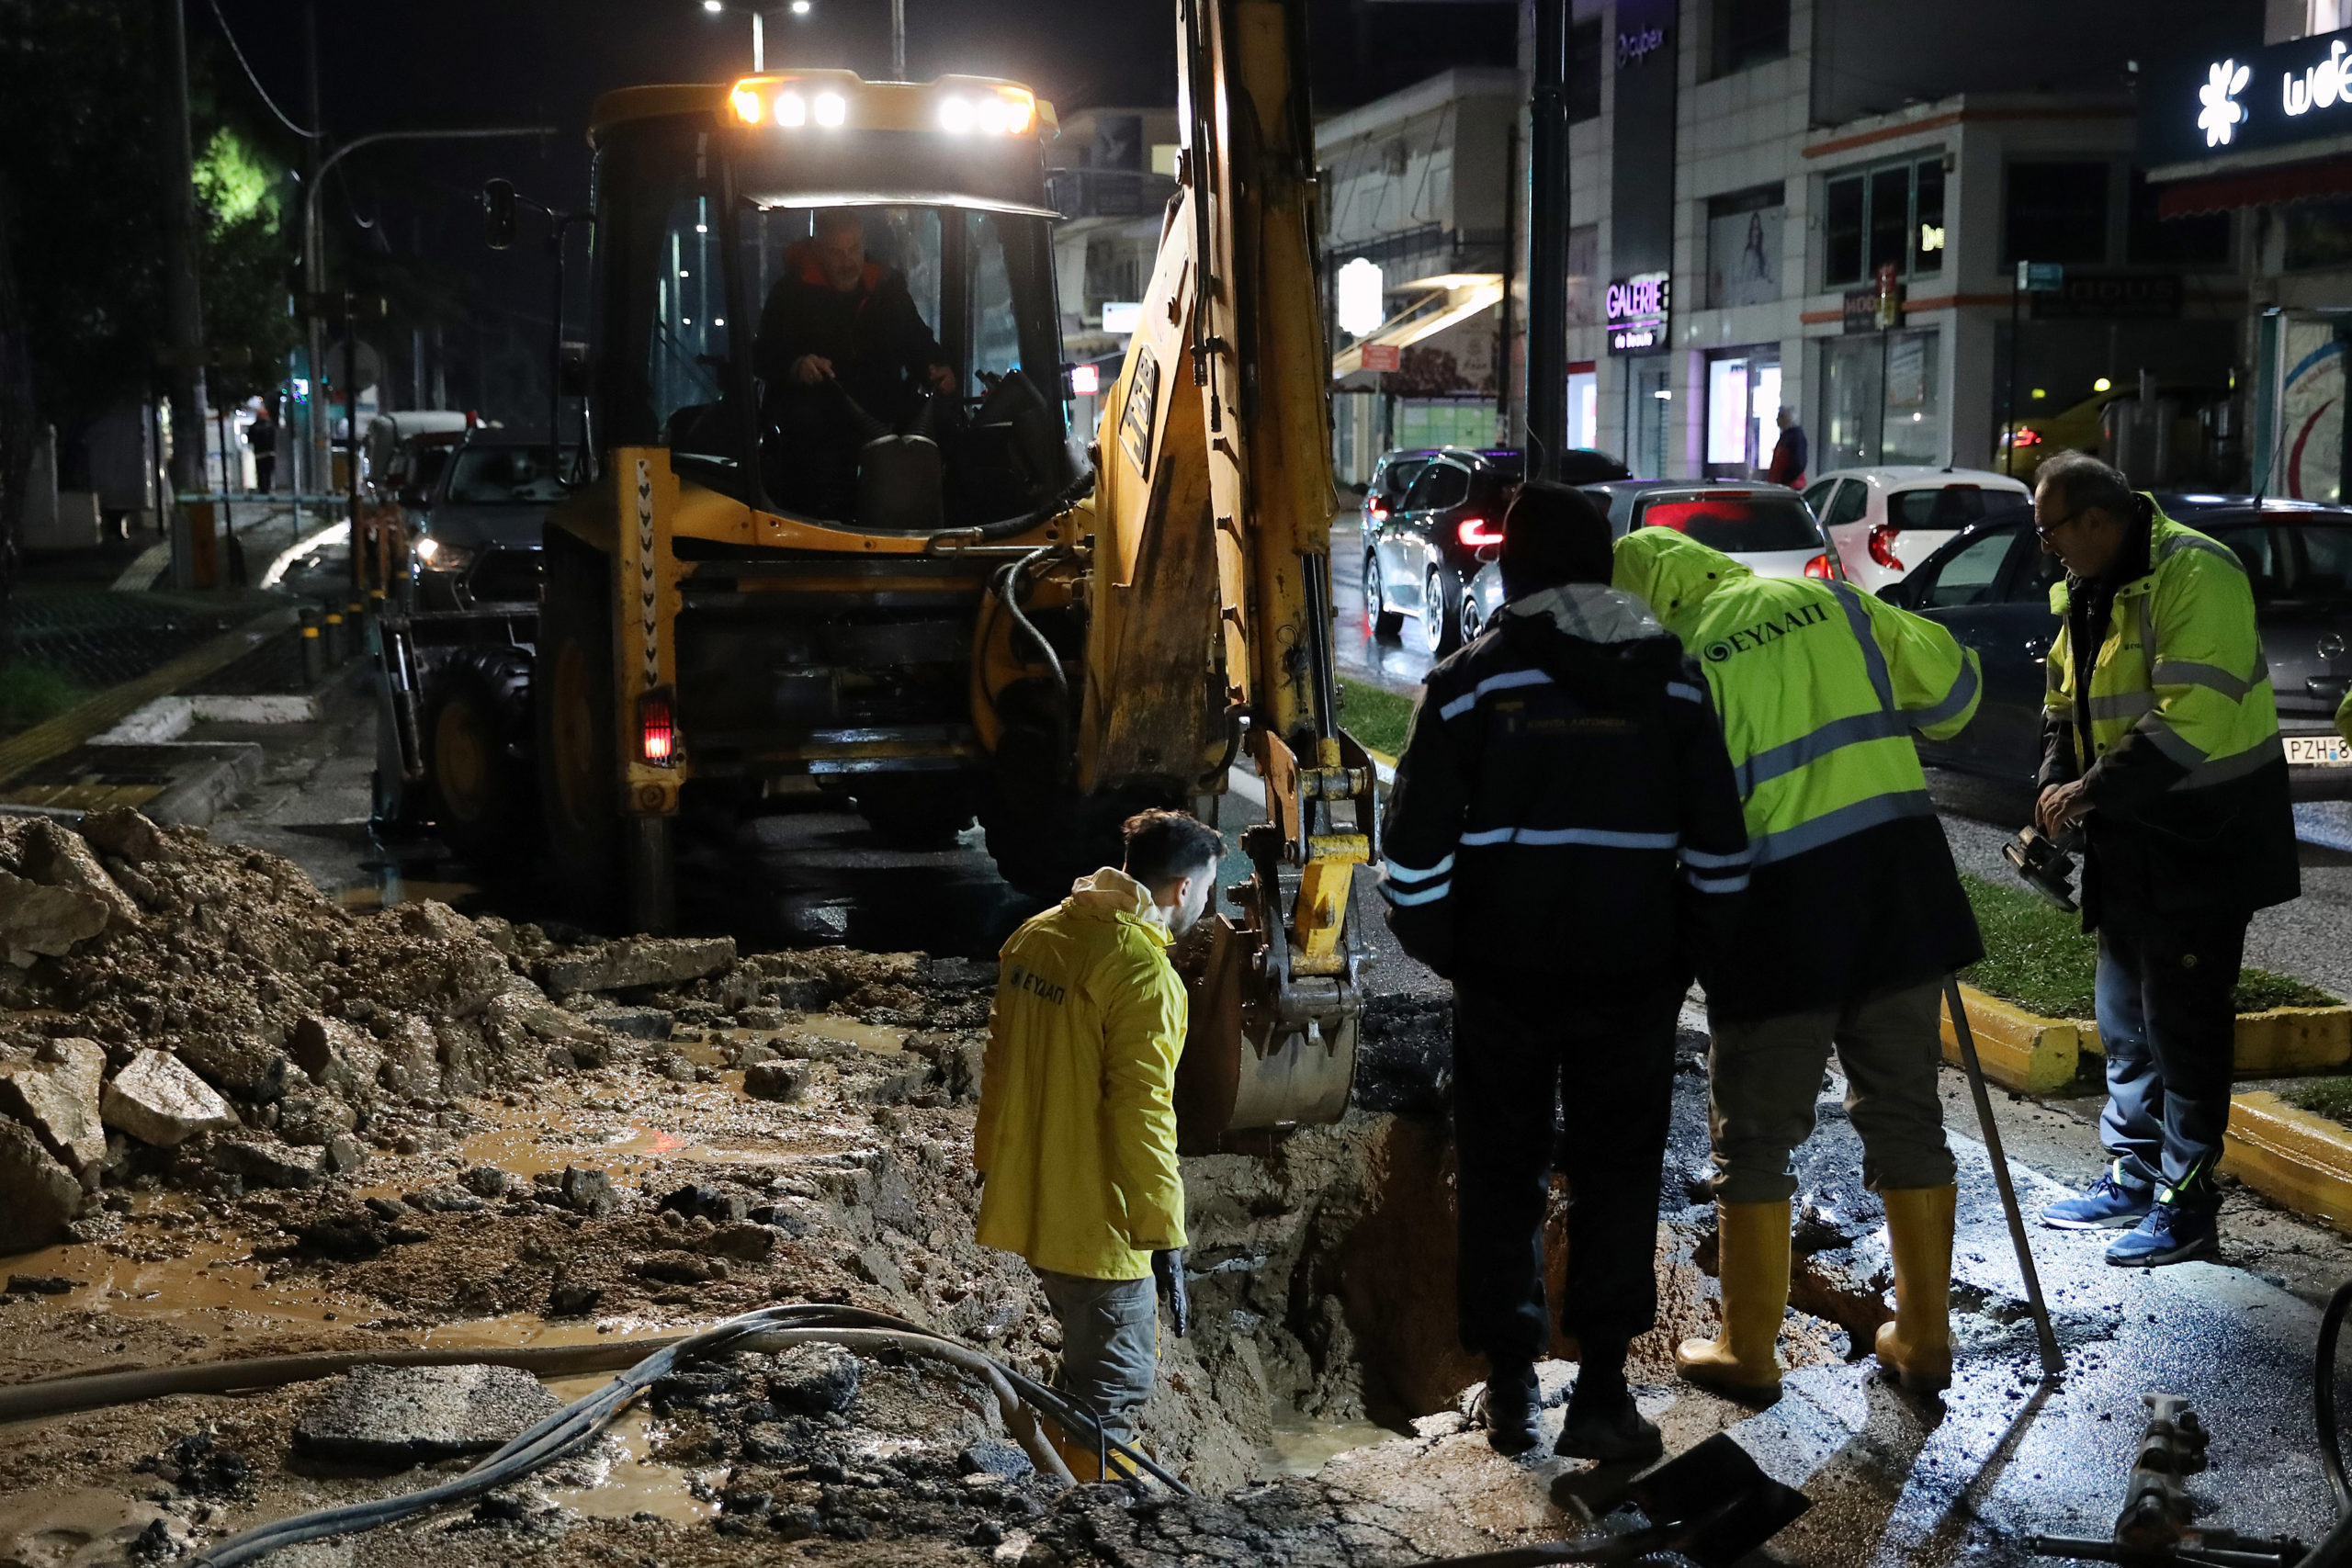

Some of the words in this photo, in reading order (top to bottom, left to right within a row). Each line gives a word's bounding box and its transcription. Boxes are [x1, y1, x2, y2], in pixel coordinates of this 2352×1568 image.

[1606, 279, 1661, 319] GALERIE
[1124, 353, 1154, 466] JCB
[1728, 603, 1828, 653] ΕΥΔΑΠ
[1023, 973, 1065, 1005] ΕΥΔΑΠ
